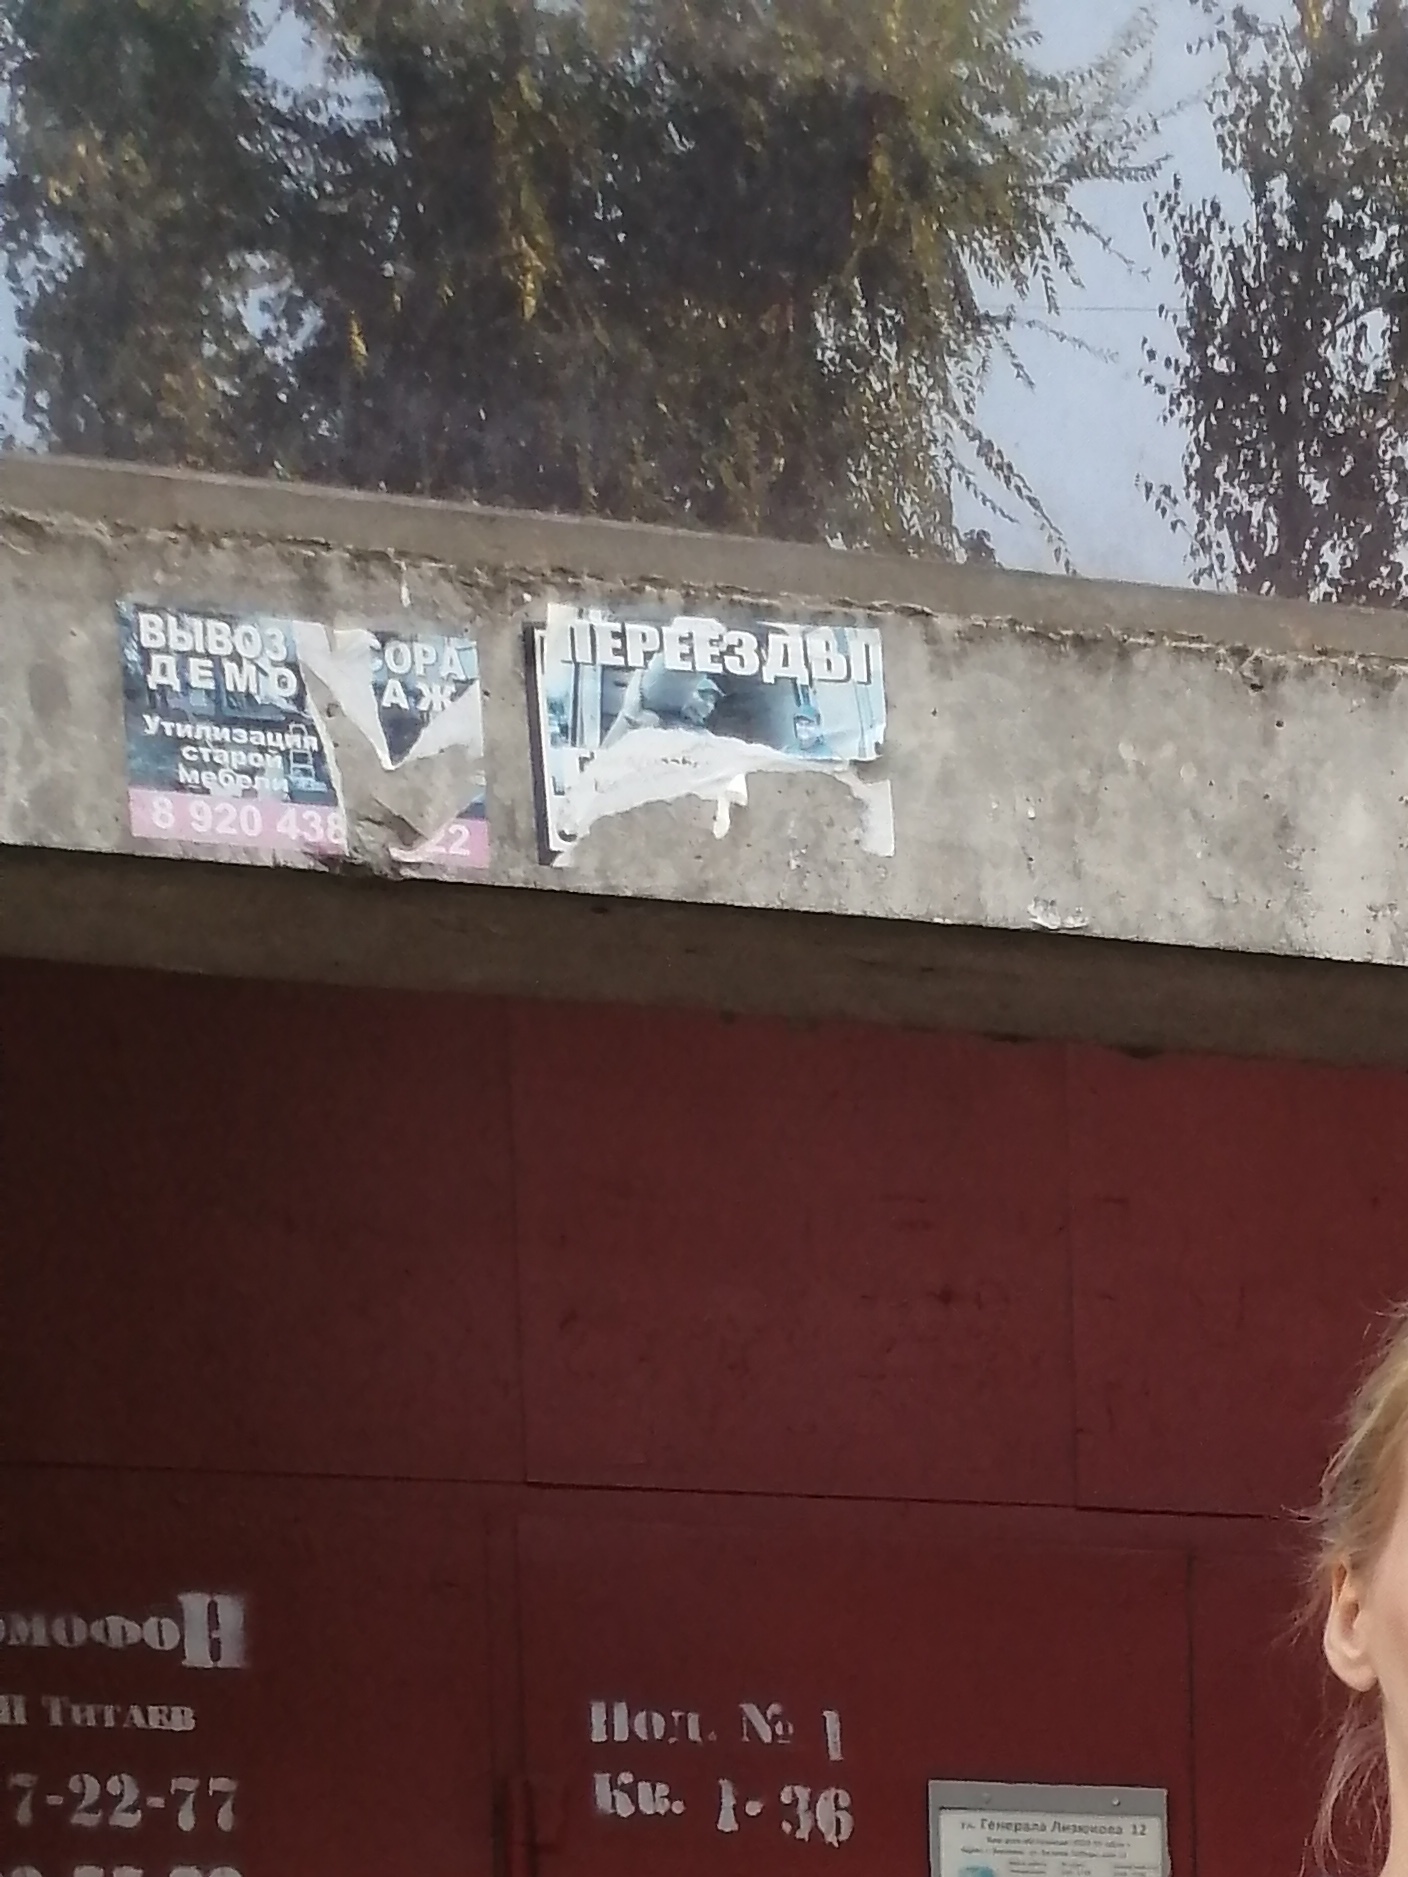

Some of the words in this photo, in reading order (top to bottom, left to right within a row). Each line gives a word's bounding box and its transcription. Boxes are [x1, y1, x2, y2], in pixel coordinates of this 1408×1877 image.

[137, 611, 289, 662] ВЫВОЗ
[180, 744, 283, 773] старой
[149, 797, 176, 831] 8
[189, 802, 263, 838] 920
[738, 1702, 794, 1744] №
[821, 1710, 844, 1761] 1
[1131, 1823, 1148, 1836] 12
